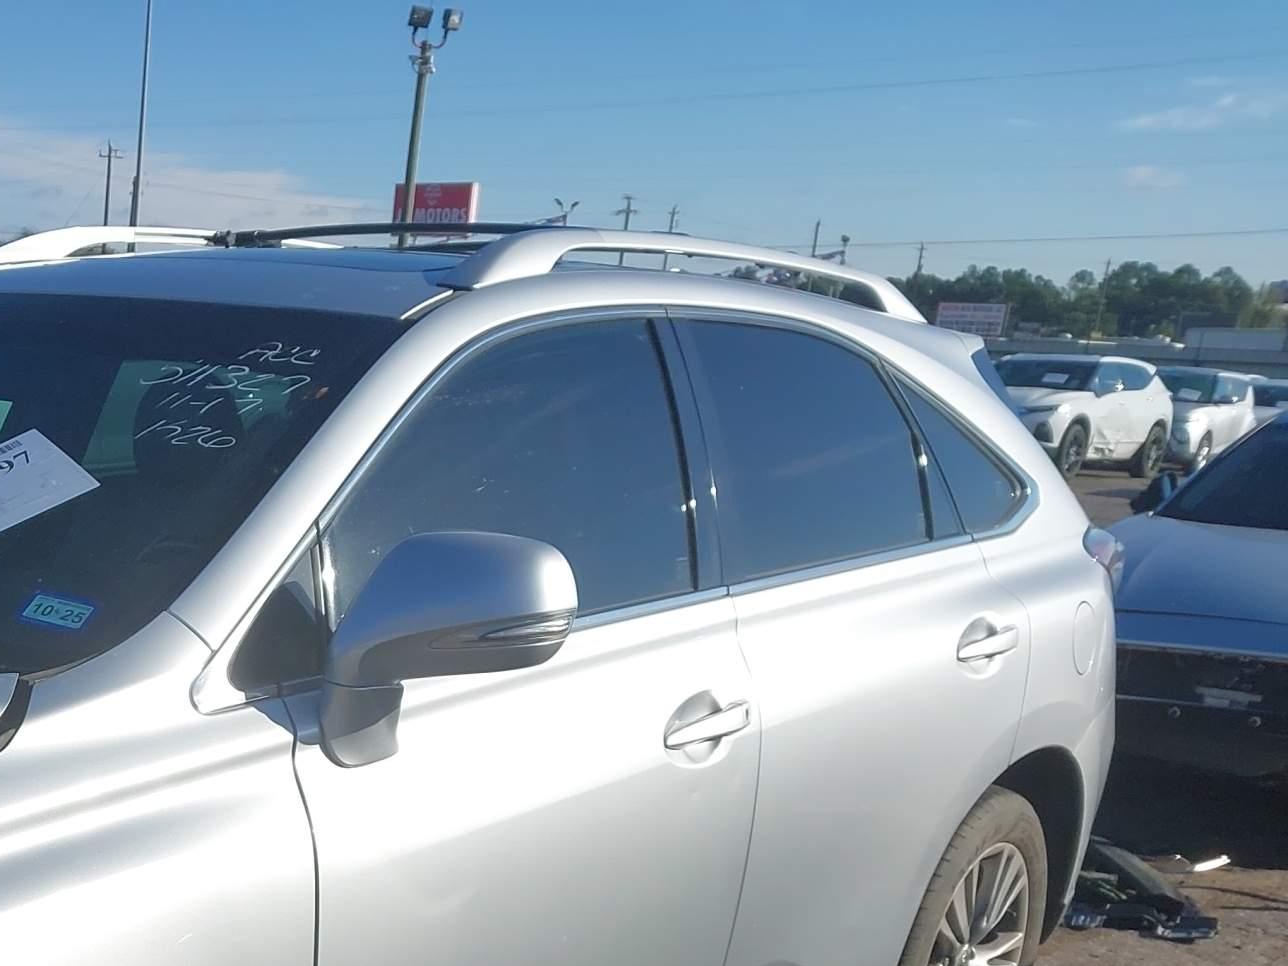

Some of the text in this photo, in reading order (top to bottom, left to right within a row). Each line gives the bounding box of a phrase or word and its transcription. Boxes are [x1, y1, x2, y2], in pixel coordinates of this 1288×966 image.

[413, 207, 467, 224] MOTORS
[32, 602, 86, 624] 10 25
